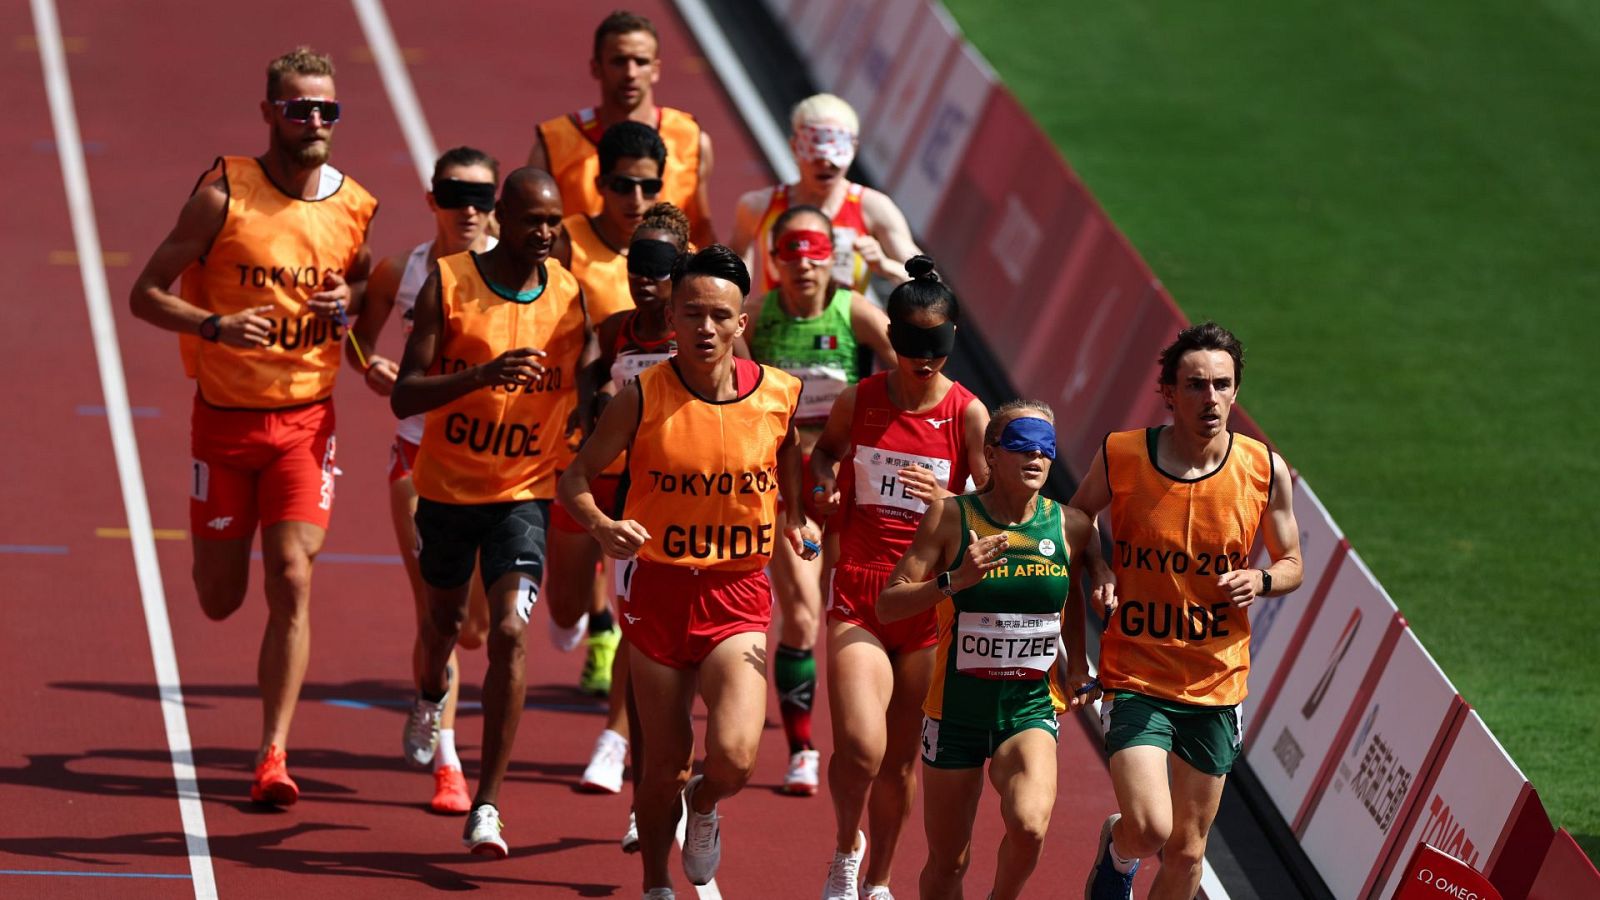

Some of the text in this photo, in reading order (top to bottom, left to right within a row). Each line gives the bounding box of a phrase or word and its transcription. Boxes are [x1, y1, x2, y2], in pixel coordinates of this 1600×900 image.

[237, 264, 318, 288] TOKYO
[445, 412, 542, 458] GUIDE
[648, 471, 733, 496] TOKYO
[663, 523, 772, 560] GUIDE
[1014, 564, 1068, 578] AFRICA
[995, 619, 1043, 629] 東京海上日動
[1120, 600, 1230, 640] GUIDE
[962, 635, 1056, 659] COETZEE
[1435, 877, 1486, 900] OMEG
